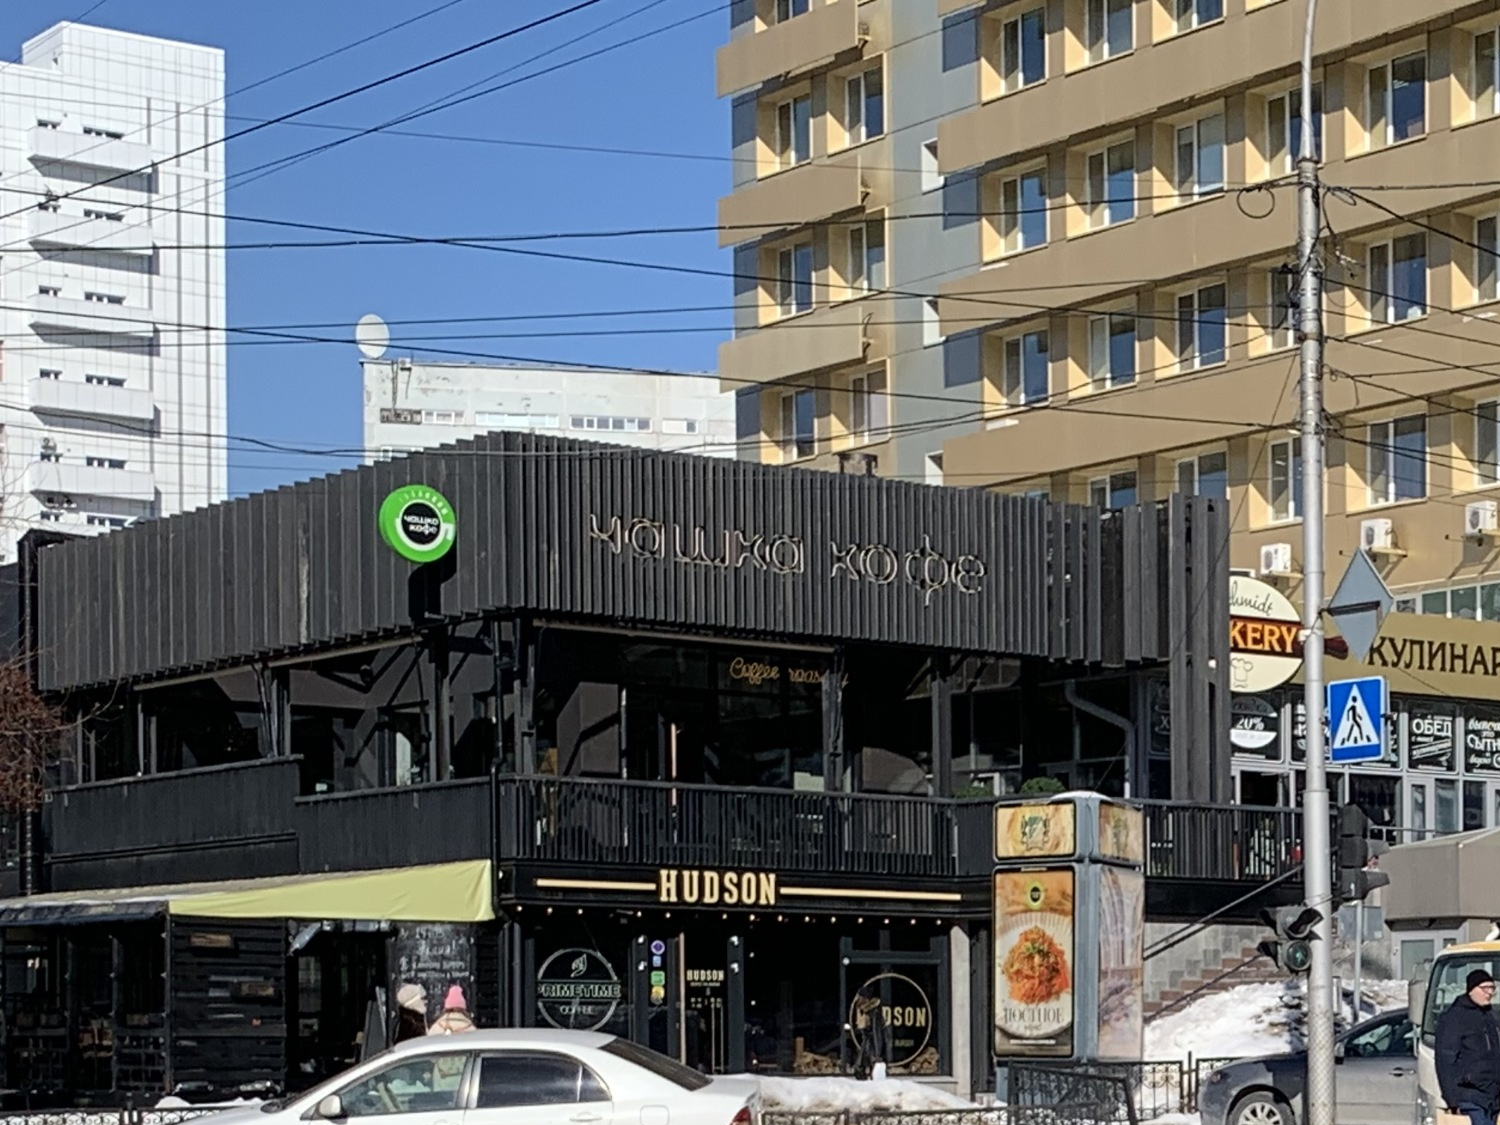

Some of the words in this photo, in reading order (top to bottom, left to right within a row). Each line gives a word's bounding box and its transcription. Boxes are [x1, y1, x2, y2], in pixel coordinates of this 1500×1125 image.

[589, 513, 805, 574] чашка
[831, 533, 986, 608] кофе
[1230, 620, 1298, 653] KERY
[730, 657, 780, 684] Coffee
[1412, 718, 1453, 737] ОБЕД
[659, 869, 776, 905] HUDSON
[686, 969, 725, 982] HUDSON
